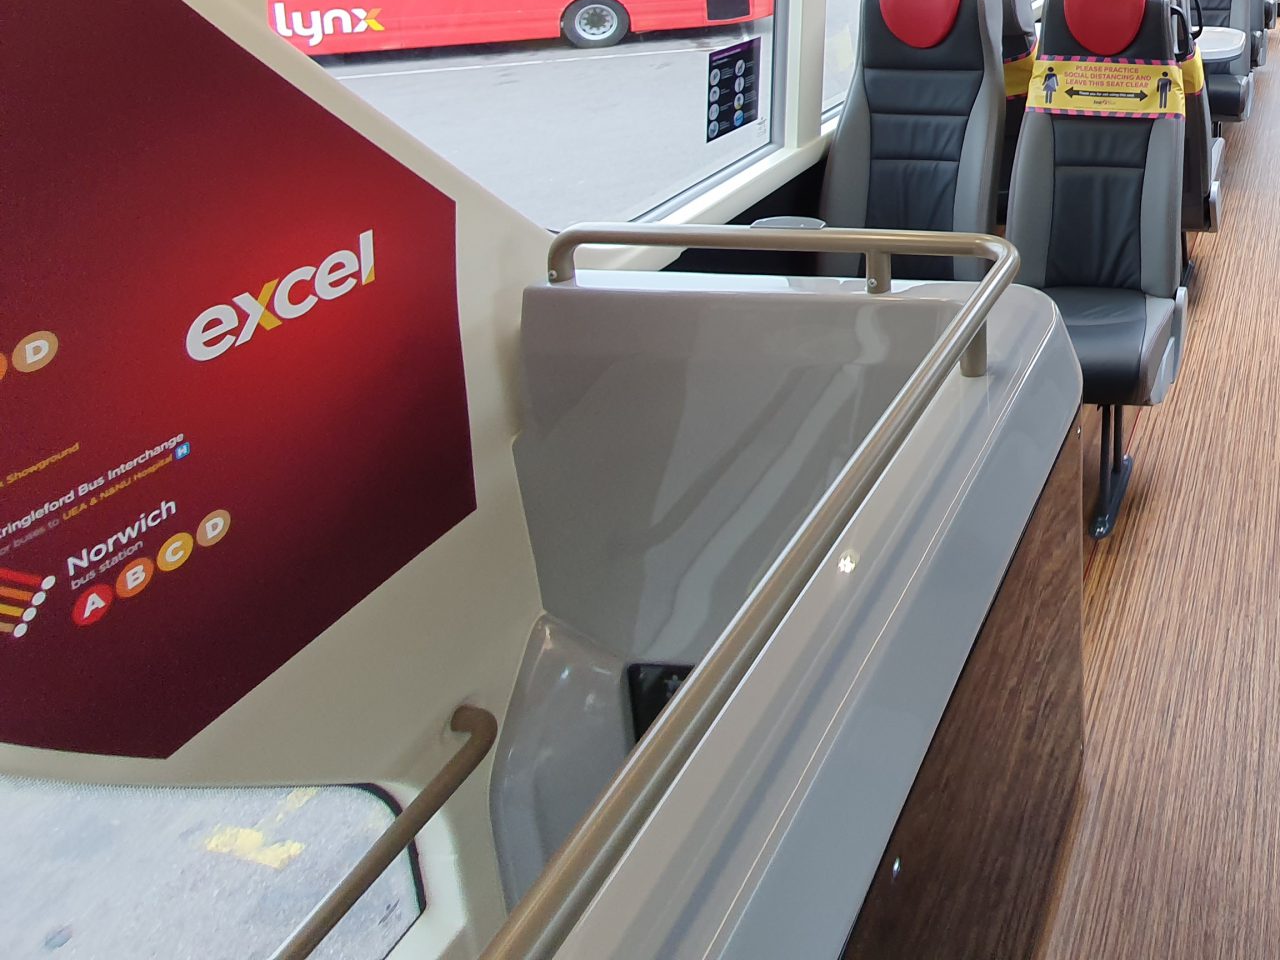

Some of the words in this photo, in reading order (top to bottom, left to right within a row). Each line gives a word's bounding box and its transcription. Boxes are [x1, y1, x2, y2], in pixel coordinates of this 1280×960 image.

[274, 2, 385, 47] lynx
[1064, 71, 1089, 79] SOCIAL
[1090, 72, 1134, 81] DISTANCING
[1135, 74, 1152, 82] AND
[1075, 65, 1101, 73] PLEASE
[1103, 66, 1139, 74] PRACTICE
[1126, 81, 1149, 89] CLEAR
[185, 227, 377, 362] excel
[25, 339, 50, 365] D
[5, 442, 81, 485] Showground
[77, 475, 106, 497] Bus
[107, 432, 185, 481] Interchange
[47, 517, 61, 529] to
[62, 503, 88, 520] UEA
[89, 496, 99, 506] &
[133, 452, 174, 481] Hospital
[66, 499, 177, 577] Norwich
[70, 568, 97, 590] bus
[98, 539, 145, 574] station
[83, 592, 106, 619] A
[125, 564, 146, 590] B
[165, 540, 185, 563] C
[205, 516, 225, 539] D
